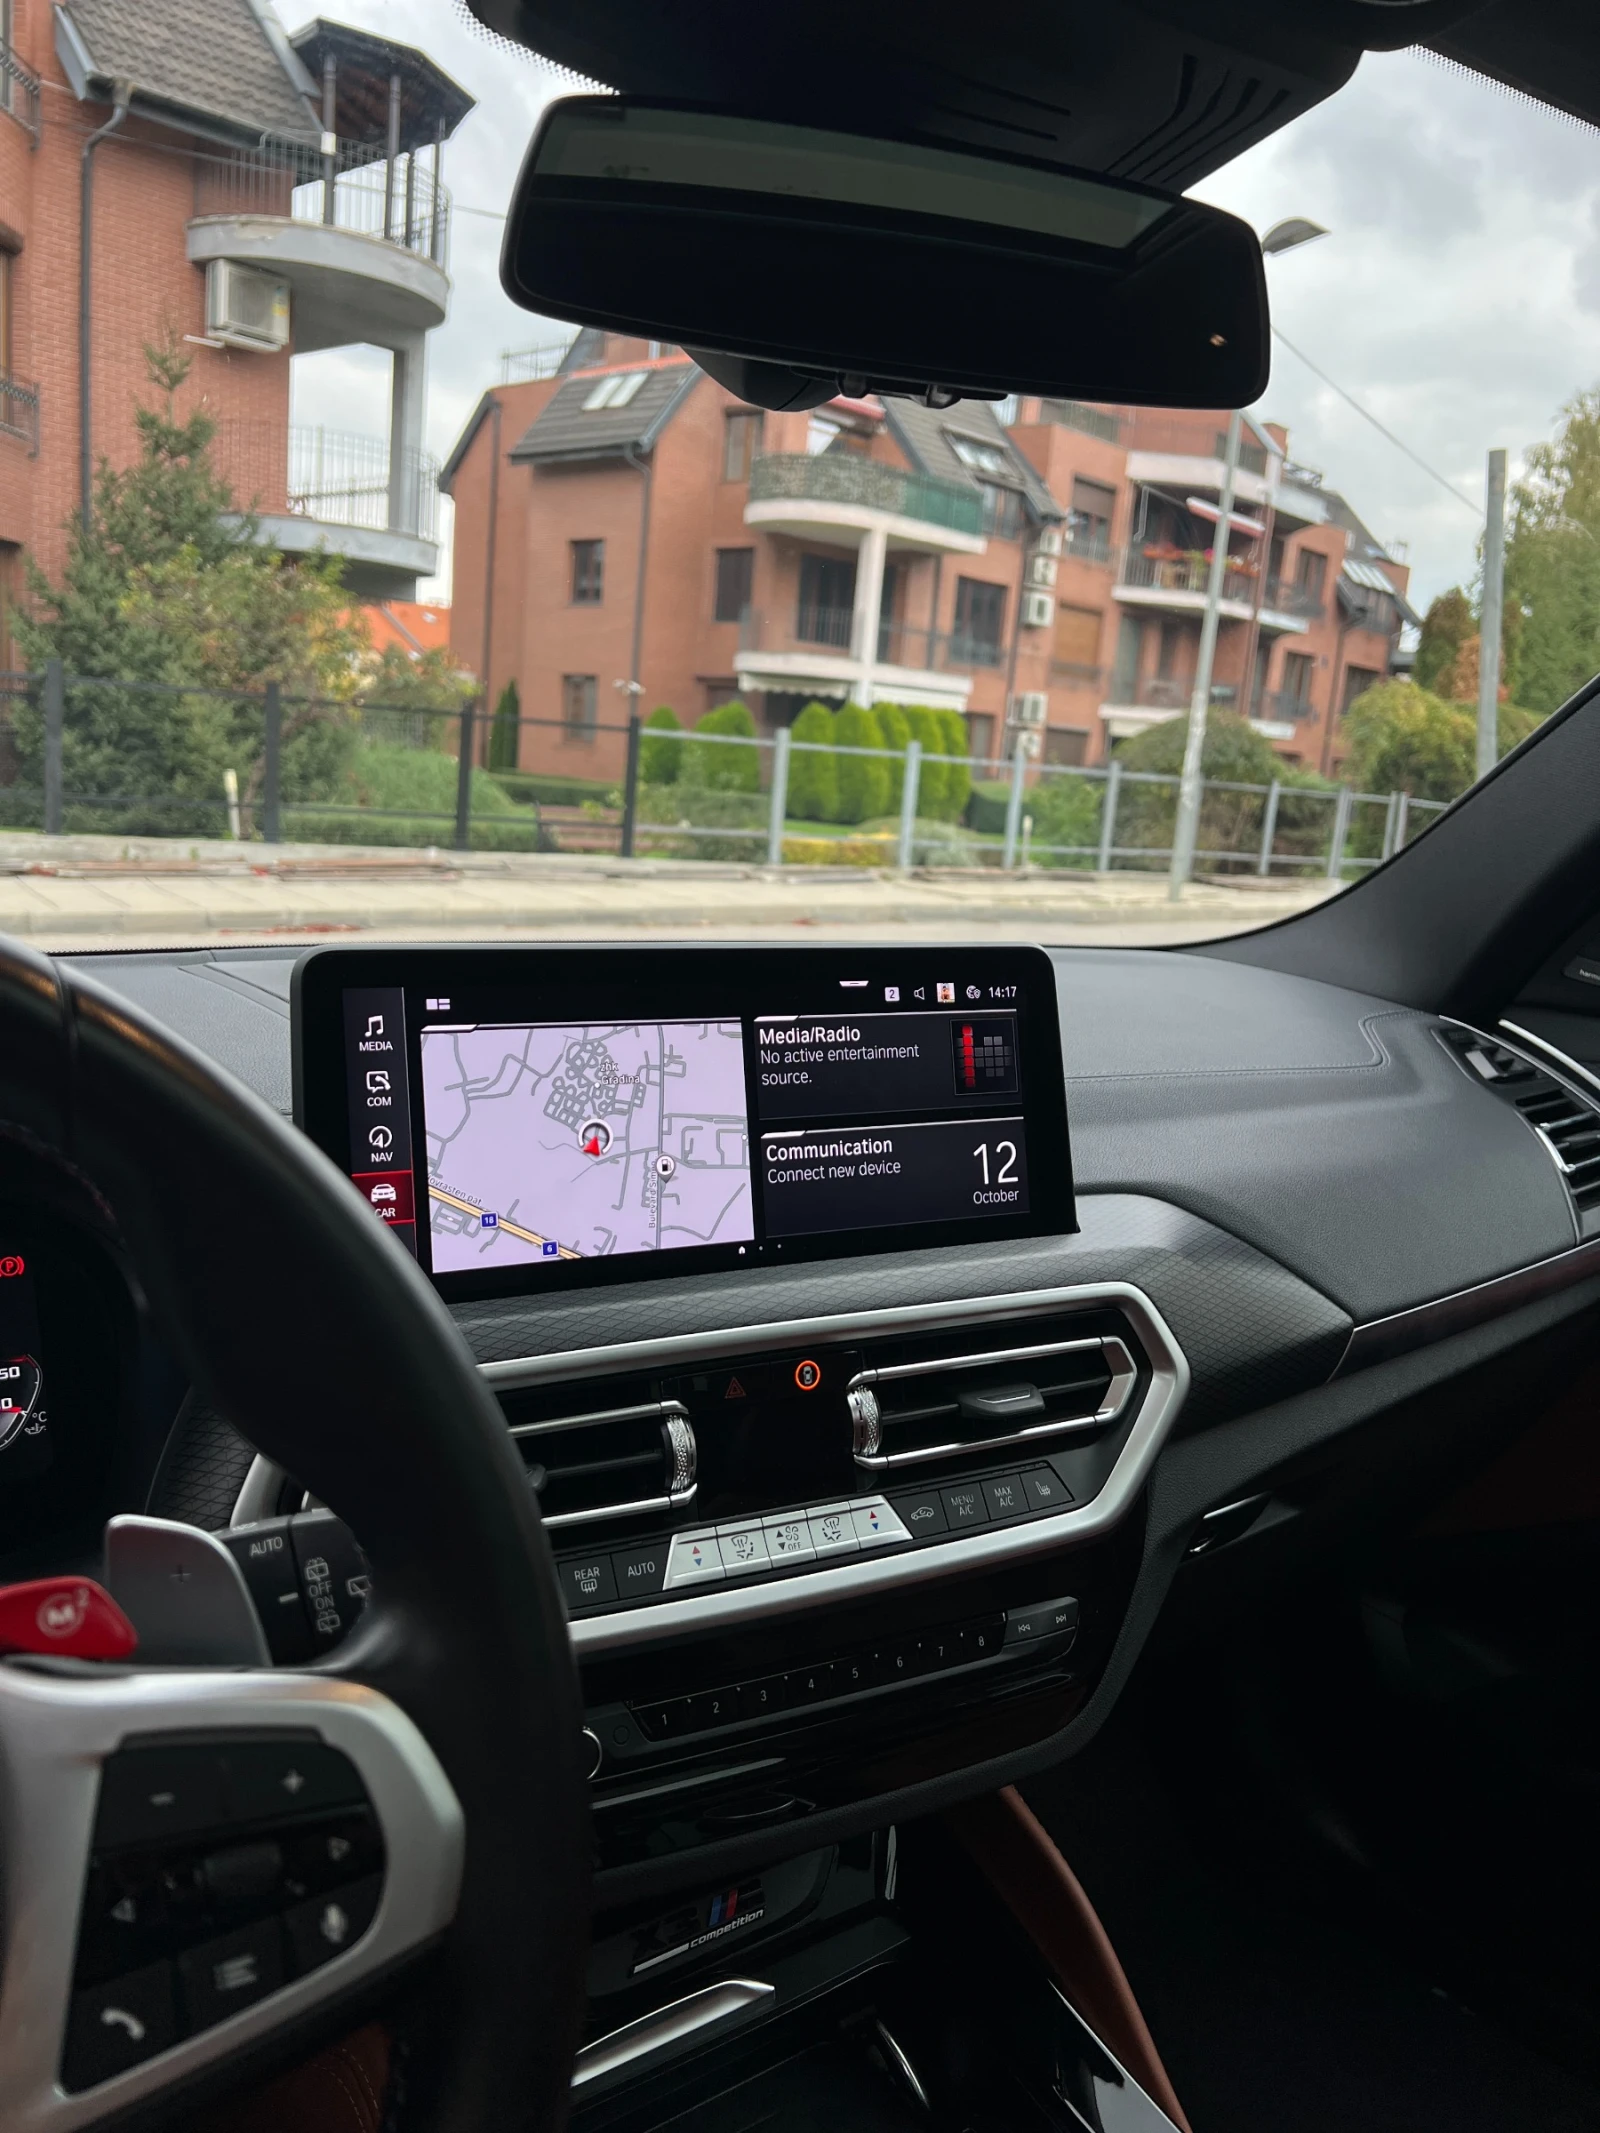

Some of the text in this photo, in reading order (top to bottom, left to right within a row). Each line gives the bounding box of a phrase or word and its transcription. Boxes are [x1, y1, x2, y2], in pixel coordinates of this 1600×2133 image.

[889, 989, 895, 999] 2
[988, 986, 1017, 998] 14:17
[759, 1026, 861, 1045] Media/Radio
[359, 1041, 393, 1051] MEDIA
[760, 1044, 920, 1064] No active entertainment
[600, 1062, 619, 1072] zhk
[601, 1074, 640, 1085] Gradina
[761, 1071, 812, 1085] source.
[367, 1096, 392, 1107] COM
[766, 1138, 893, 1161] Communication
[371, 1152, 394, 1162] NAV
[973, 1141, 1019, 1185] 12
[767, 1160, 901, 1183] Connect new device
[972, 1189, 1020, 1204] October
[375, 1207, 396, 1218] CAR
[648, 1190, 657, 1229] Bulevard
[484, 1216, 494, 1224] 18
[547, 1244, 553, 1253] 6
[994, 1485, 1013, 1497] MAX
[951, 1494, 975, 1507] MENU
[1000, 1496, 1014, 1507] A/C
[959, 1505, 974, 1516] A/C
[250, 1536, 283, 1557] AUTO
[788, 1541, 802, 1551] OFF
[574, 1566, 600, 1581] REAR
[627, 1561, 656, 1577] AUTO
[308, 1580, 333, 1598] OFF
[315, 1594, 335, 1610] ON
[978, 1635, 985, 1647] 8
[938, 1646, 944, 1657] 7
[896, 1656, 903, 1668] 6
[852, 1667, 859, 1679] 5
[808, 1678, 815, 1689] 4
[760, 1689, 767, 1702] 3
[713, 1701, 720, 1714] 2
[661, 1713, 668, 1726] 1
[690, 1908, 764, 1948] competition
